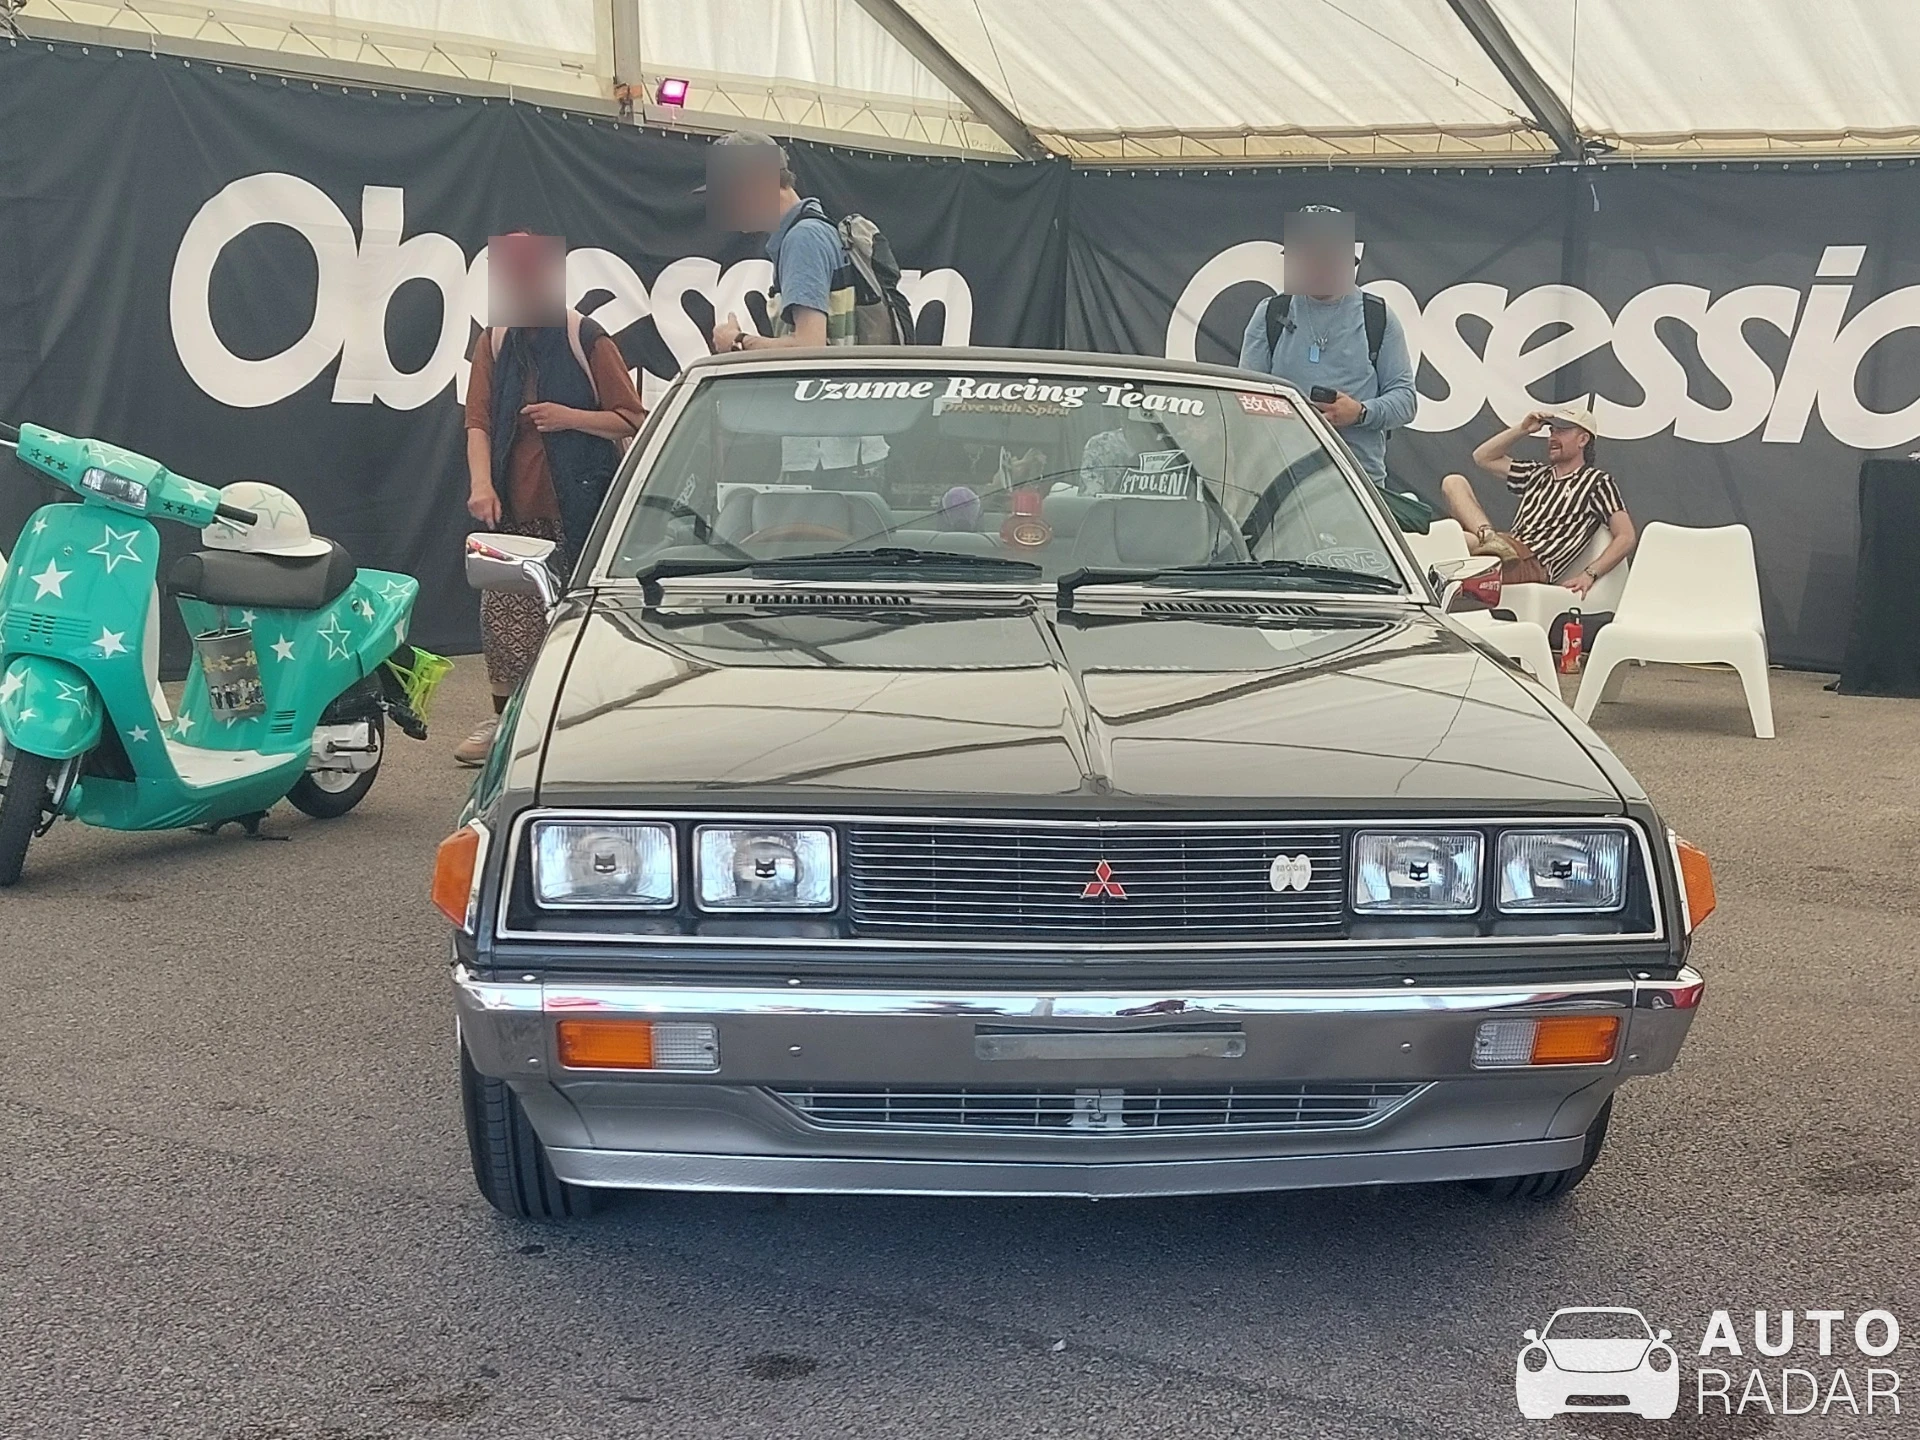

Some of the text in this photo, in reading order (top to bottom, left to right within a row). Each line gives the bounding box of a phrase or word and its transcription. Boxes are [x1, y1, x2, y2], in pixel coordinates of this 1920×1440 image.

[794, 376, 1206, 417] Uzume Racing Team
[943, 401, 985, 414] Drive
[989, 402, 1022, 414] with
